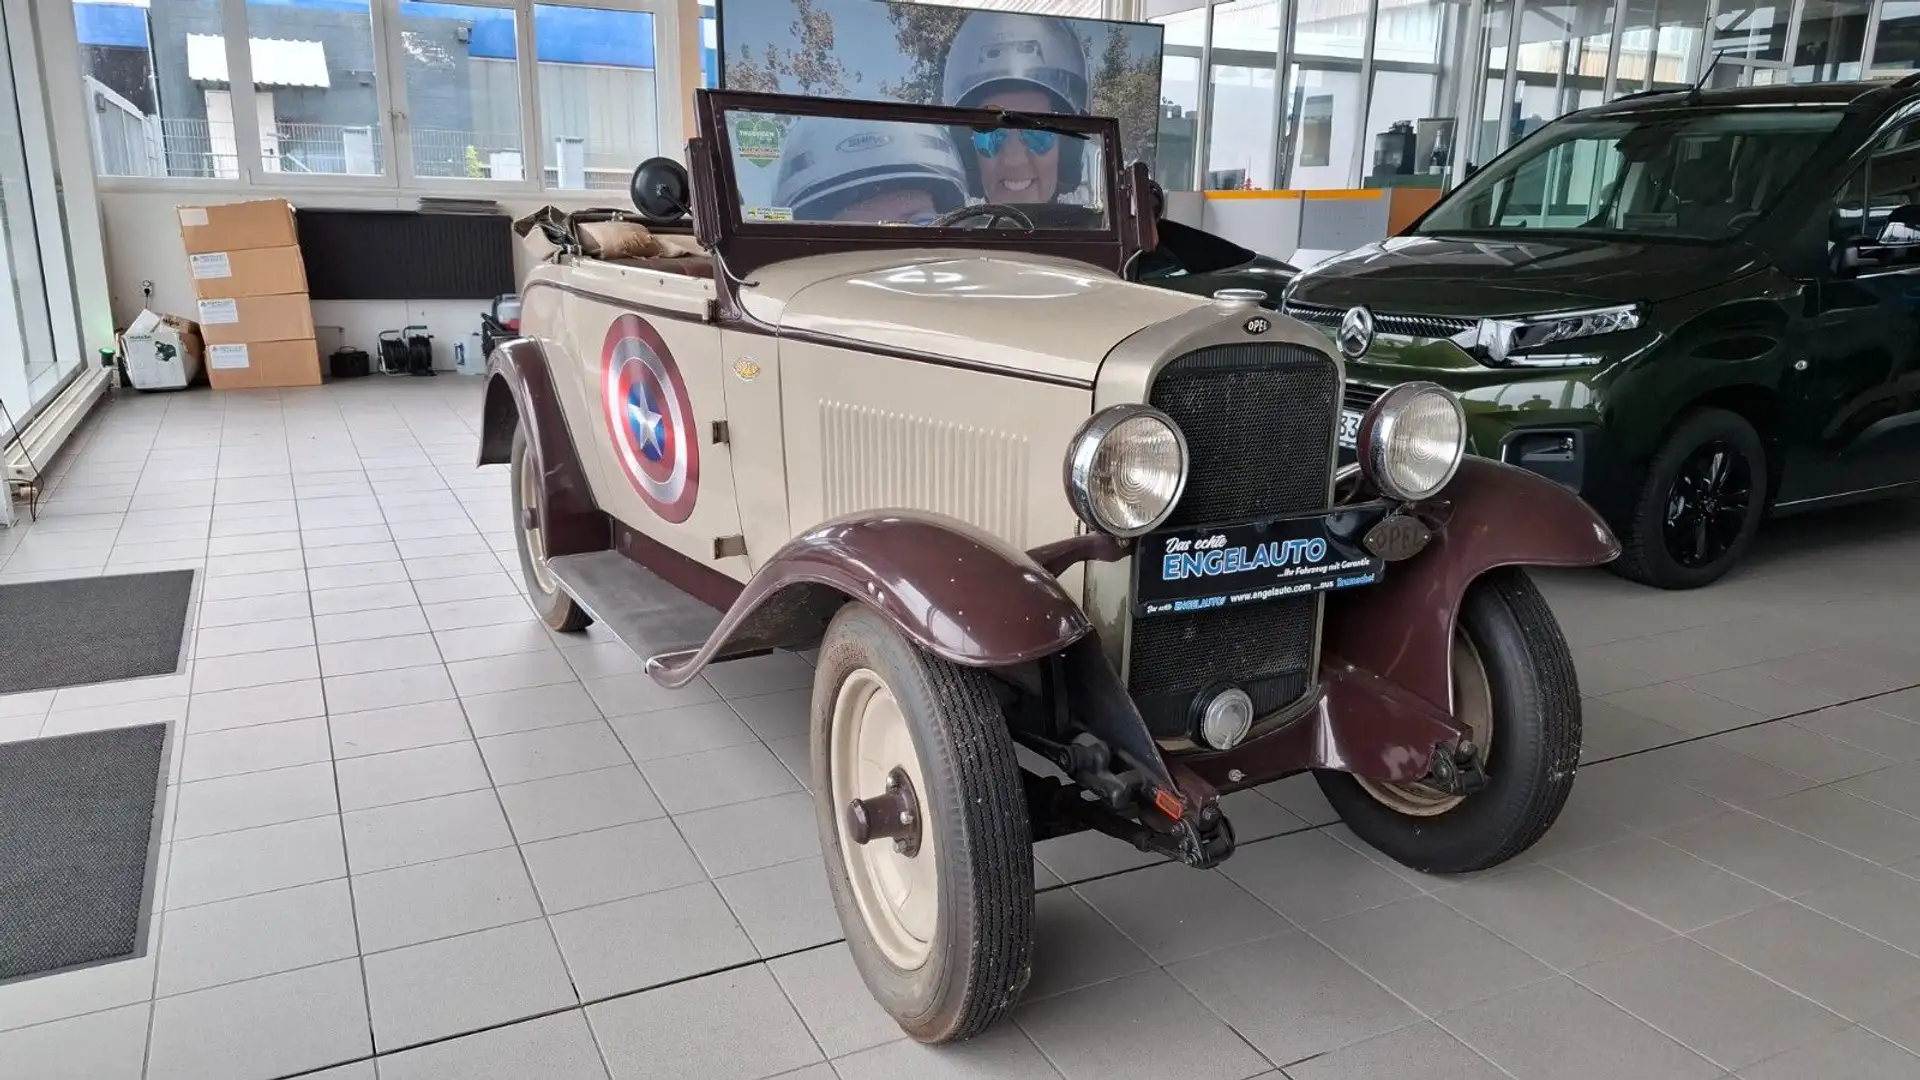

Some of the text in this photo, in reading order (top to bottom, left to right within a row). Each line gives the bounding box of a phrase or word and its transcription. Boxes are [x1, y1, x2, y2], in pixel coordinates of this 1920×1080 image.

[1248, 319, 1268, 333] OPEL
[1166, 534, 1228, 553] Das echte
[1376, 524, 1424, 553] OPEL
[1163, 538, 1327, 580] ENGELAUTO
[1295, 565, 1328, 576] Fahrzeug
[1329, 561, 1341, 571] mit
[1341, 557, 1370, 569] Garantie
[1230, 583, 1312, 603] www.engelauto.com
